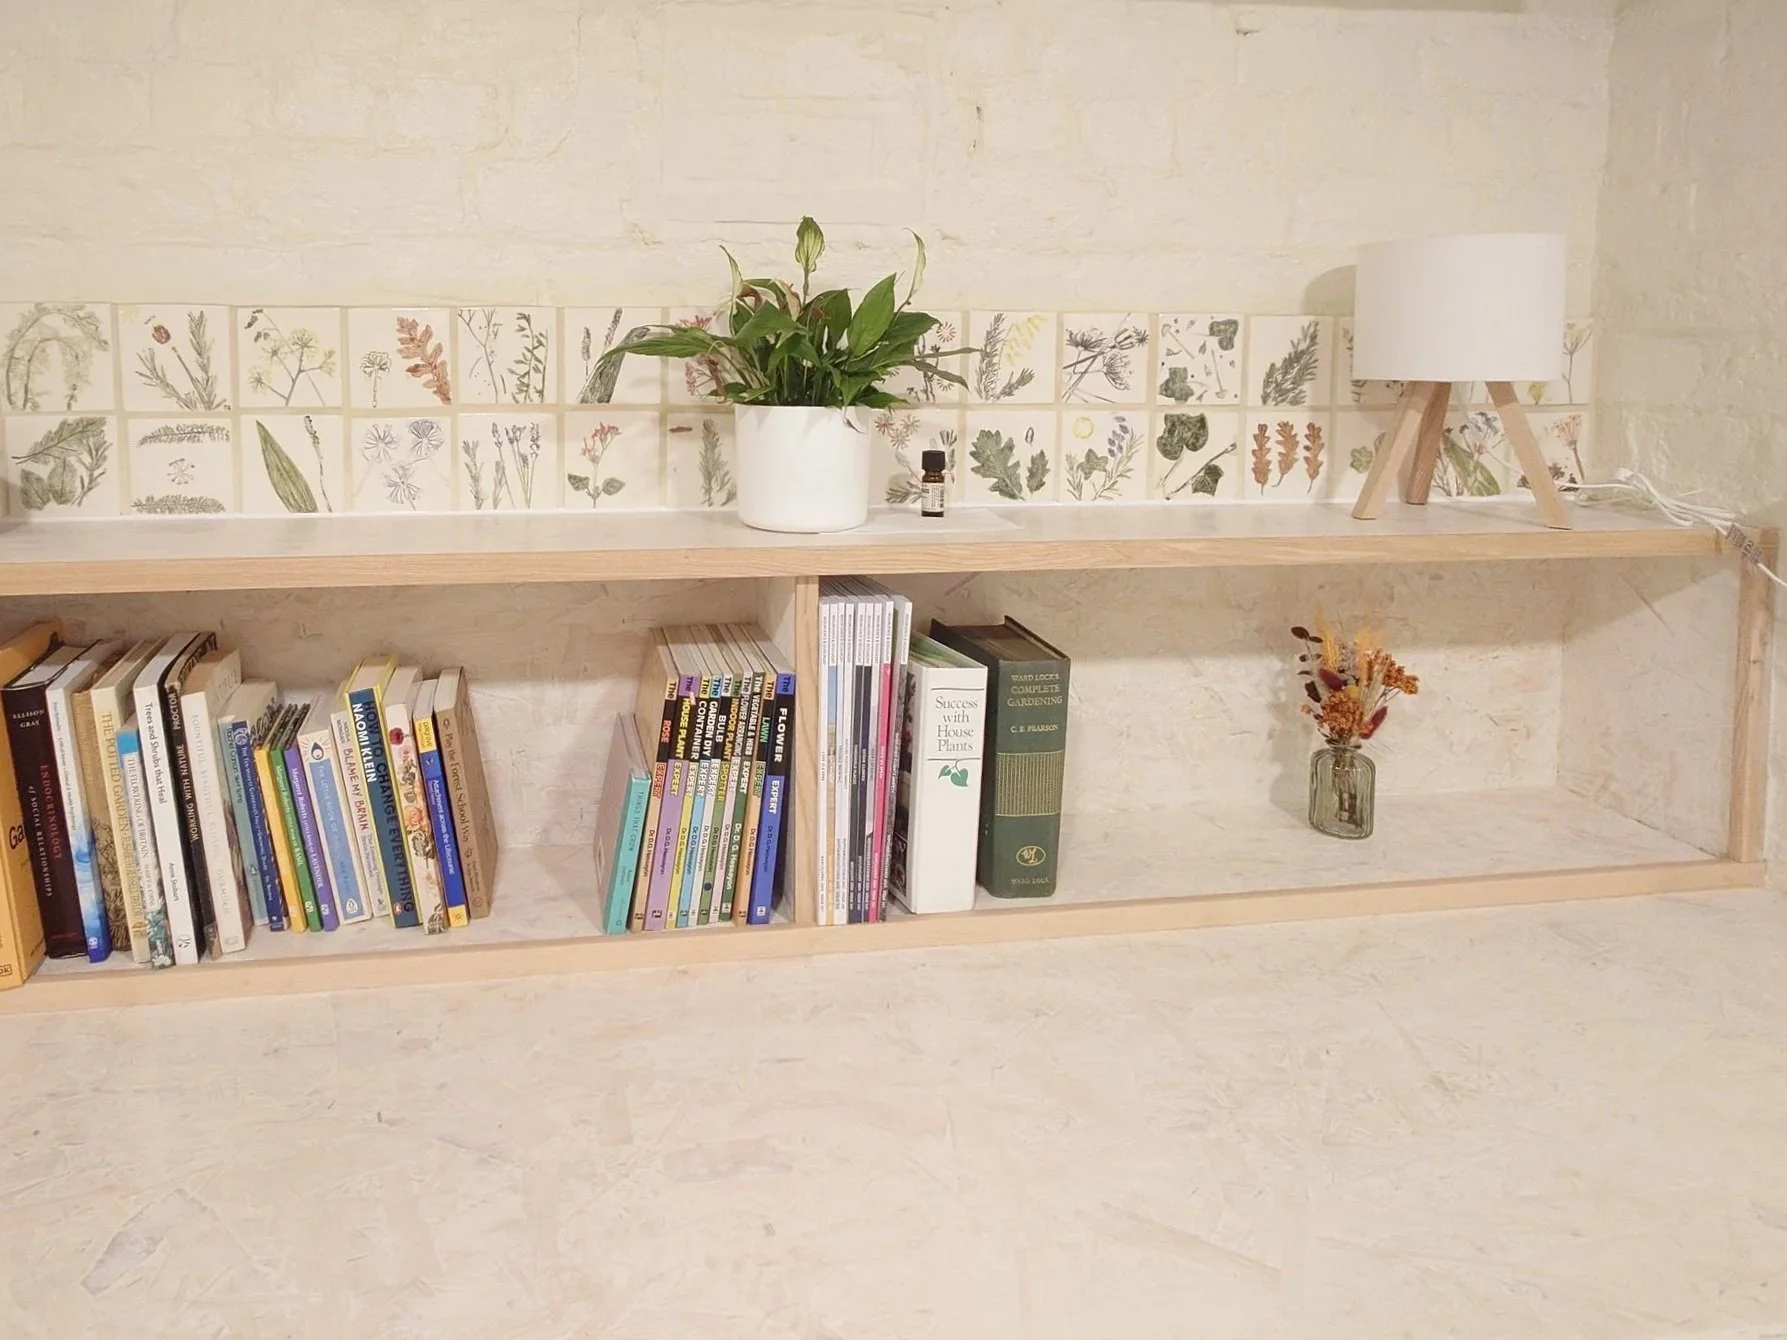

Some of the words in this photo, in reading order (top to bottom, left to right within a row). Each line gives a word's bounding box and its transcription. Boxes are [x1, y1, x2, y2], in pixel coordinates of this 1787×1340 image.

[666, 681, 676, 699] The
[684, 675, 693, 692] The
[700, 678, 709, 695] The
[711, 678, 720, 696] The
[722, 676, 731, 694] The
[732, 679, 741, 696] The
[742, 676, 751, 693] The
[752, 675, 762, 693] The
[765, 681, 774, 699] The
[781, 675, 791, 693] The
[1011, 684, 1060, 694] COMPLETE
[12, 709, 45, 719] ELLISON
[143, 703, 155, 724] Trees
[168, 692, 181, 729] PROCTOR
[678, 697, 692, 728] HOUSE
[727, 697, 739, 731] INDOOR
[738, 693, 749, 720] FLOWER
[747, 693, 760, 730] VEGETABLE
[936, 696, 978, 709] Success
[1007, 696, 1063, 707] GARDENING
[20, 720, 40, 728] GRAY
[100, 711, 114, 736] THE
[352, 702, 369, 746] NAOMI
[363, 700, 380, 736] HOW
[689, 699, 707, 760] CONTAINER
[704, 700, 717, 738] GARDEN
[714, 713, 726, 743] BULB
[759, 716, 770, 743] LAWN
[943, 710, 970, 723] with
[1027, 723, 1059, 732] PEARSON
[147, 724, 157, 740] and
[660, 719, 672, 743] ROSE
[674, 728, 687, 759] PLANT
[733, 720, 745, 756] ARRANGING
[773, 707, 788, 762] FLOWER
[937, 725, 974, 738] House
[105, 737, 121, 781] POTTED
[149, 740, 162, 768] Shrubs
[177, 743, 188, 775] NATURE
[371, 740, 384, 758] TO
[702, 738, 712, 756] DIY
[722, 731, 734, 760] PLANT
[743, 737, 754, 756] HERB
[937, 739, 974, 752] Plants
[127, 758, 136, 773] THE
[154, 768, 164, 785] that
[342, 747, 359, 782] BLAME
[360, 746, 377, 783] KLEIN
[450, 762, 463, 792] Forest
[728, 760, 740, 792] EXPERT
[739, 760, 751, 794] EXPERT
[182, 778, 192, 799] WITH
[350, 783, 363, 798] MY
[651, 762, 665, 798] EXPERT
[669, 761, 682, 796] EXPERT
[684, 762, 697, 797] EXPERT
[696, 761, 708, 797] EXPERT
[707, 763, 719, 796] EXPERT
[716, 762, 729, 802] SPOTTER
[752, 762, 764, 797] EXPERT
[156, 785, 167, 804] Heal
[375, 761, 397, 824] CHANGE
[431, 778, 445, 813] Attachment
[767, 779, 780, 814] EXPERT
[40, 764, 63, 859] ENDOCRINOLOGY
[112, 783, 129, 832] GARDEN
[186, 802, 199, 840] WORKING
[325, 800, 336, 822] BOOK
[354, 799, 370, 831] BRAIN
[455, 792, 469, 824] School
[290, 767, 303, 795] Margaret
[297, 795, 308, 819] Roberts
[310, 853, 324, 888] LAVENDER
[438, 813, 447, 833] across
[631, 816, 639, 832] THAT
[733, 822, 741, 834] Dr.
[8, 824, 25, 850] Ga
[29, 796, 40, 827] SOCIAL
[35, 831, 53, 897] RELATIONSHIPS
[441, 833, 450, 844] the
[731, 844, 738, 853] G.
[732, 834, 740, 844] D.
[168, 862, 176, 878] Anne
[388, 827, 414, 912] EVERYTHING
[443, 843, 456, 875] Lifecourse
[725, 853, 737, 890] Hessayon
